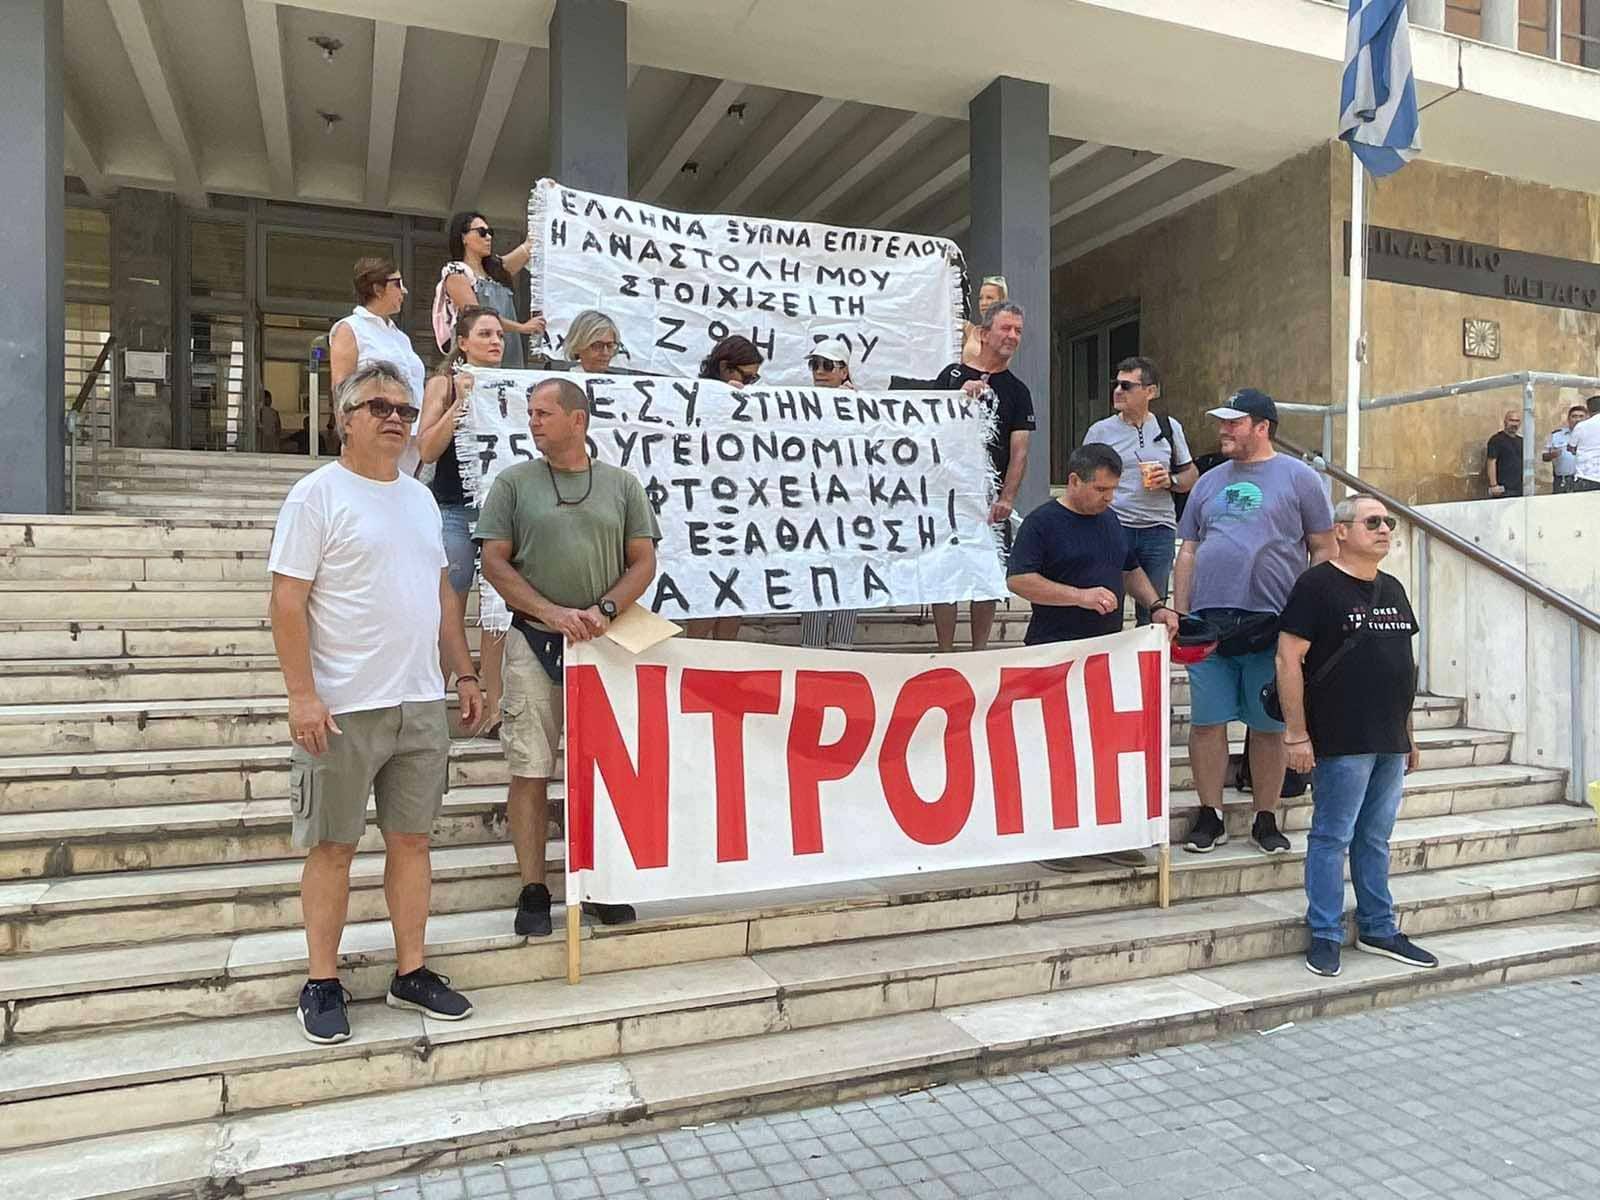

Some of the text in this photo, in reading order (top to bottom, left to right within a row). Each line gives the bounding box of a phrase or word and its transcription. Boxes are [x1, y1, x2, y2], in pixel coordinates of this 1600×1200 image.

[561, 189, 707, 240] ΕΛΛΗΝΑ
[726, 218, 811, 249] ΞΥΠΝΑ
[551, 218, 891, 291] Η ΑΝΑΣΤΟΛΗ ΜΟΥ
[1369, 229, 1501, 273] ΙΚΑΣΤΙΚΟ
[618, 273, 866, 317] ΣΤΟΙΧΙΖΕΙ ΤΗ
[731, 391, 823, 423] ΣΤΗΝ
[613, 428, 942, 469] ΥΓΕΙΟΝΟΜΙΚΟΙ
[867, 474, 928, 507] ΚΑΙ
[651, 563, 893, 613] ΑΧΕΠΑ
[566, 650, 1162, 872] ΝΤΡΟΠΗ
